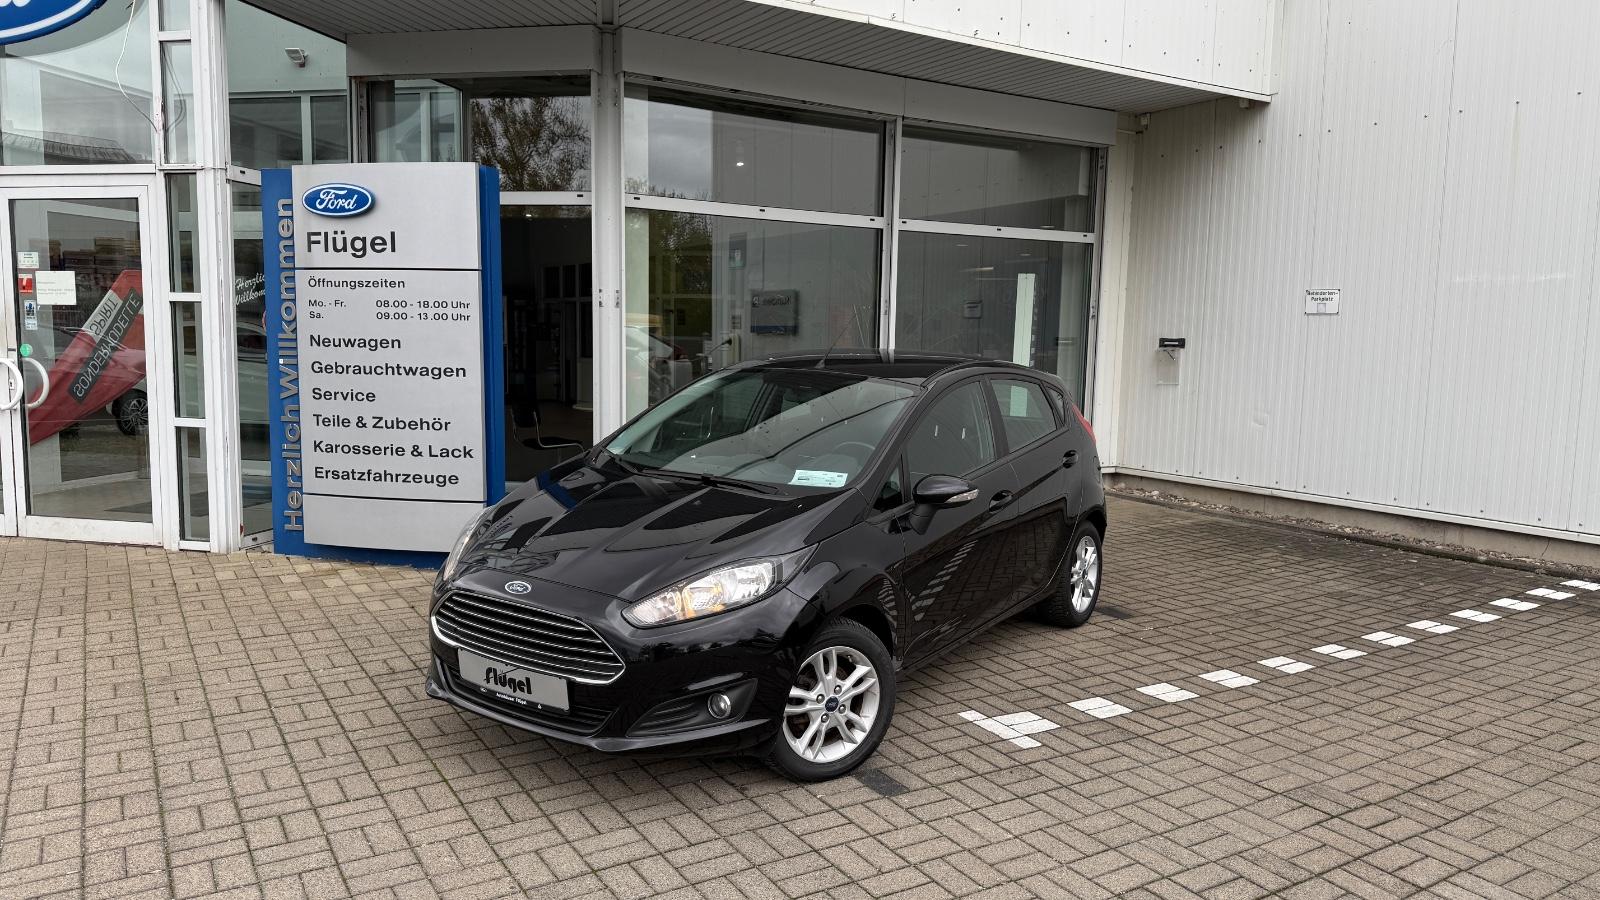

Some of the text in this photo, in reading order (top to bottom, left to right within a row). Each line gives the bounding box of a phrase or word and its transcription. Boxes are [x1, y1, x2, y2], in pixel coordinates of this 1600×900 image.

[315, 188, 357, 211] Ford
[306, 231, 396, 259] Flügel
[308, 276, 406, 290] Öffnungszeiten
[308, 299, 327, 308] Mo.
[334, 299, 347, 308] Fr.
[375, 300, 408, 309] 08.00
[416, 301, 449, 309] 18.00
[451, 301, 471, 310] Uhr
[309, 311, 324, 319] Sa.
[375, 312, 408, 321] 09.00
[416, 313, 449, 321] 13.00
[451, 313, 471, 322] Uhr
[310, 335, 402, 352] Neuwagen
[278, 198, 303, 531] Herzlich Willkommen
[311, 361, 467, 381] Gebrauchtwagen
[312, 387, 377, 403] Service
[313, 414, 452, 432] Teile & Zubehör
[313, 440, 475, 459] Karosserie & Lack
[314, 467, 460, 488] Ersatzfahrzeuge
